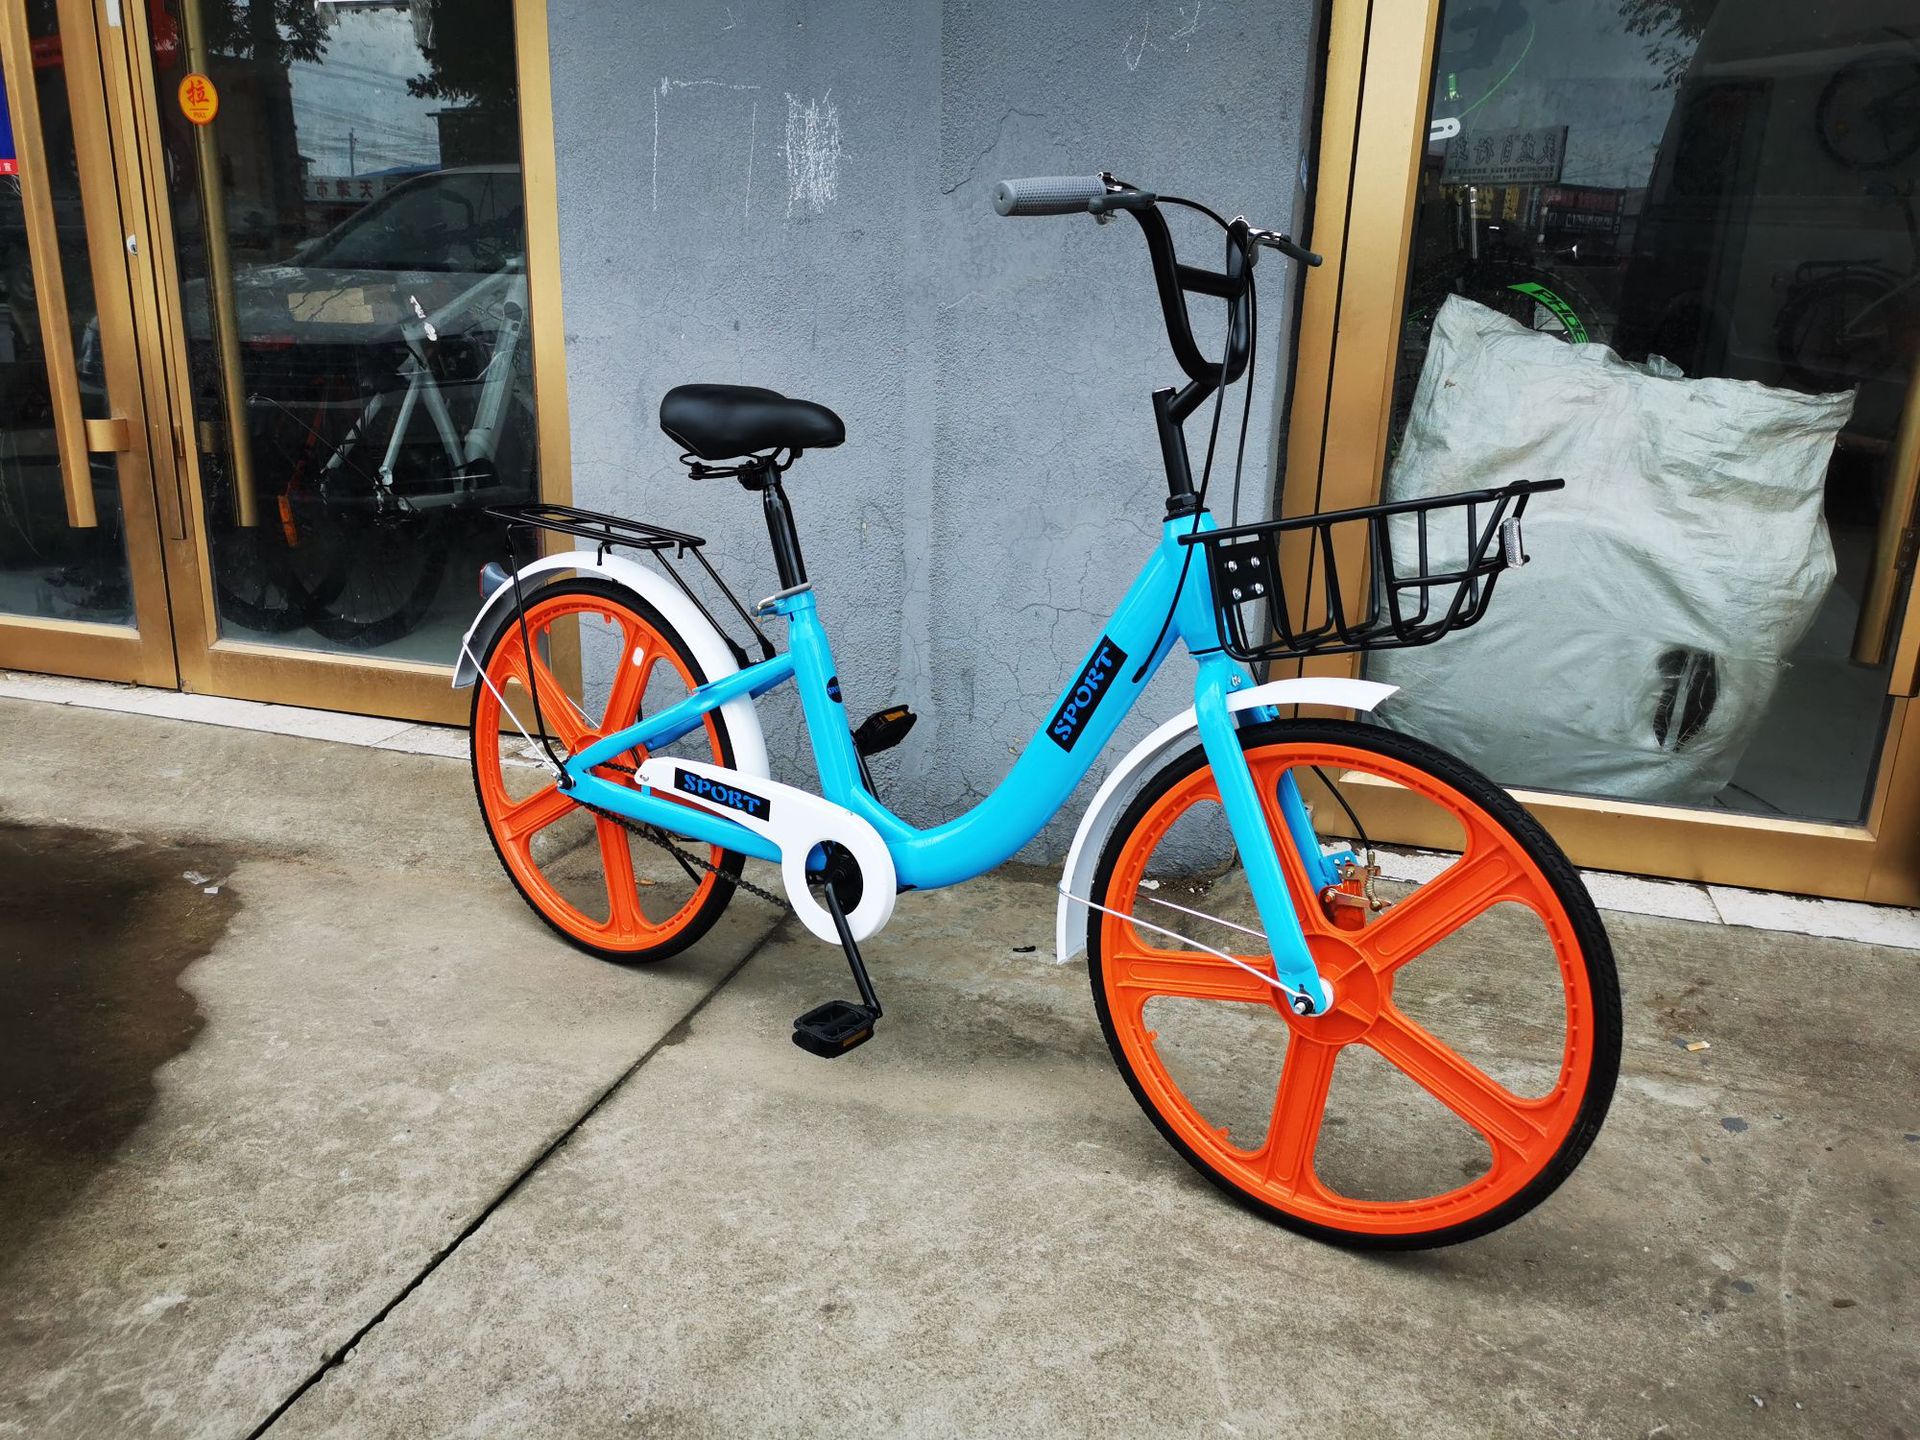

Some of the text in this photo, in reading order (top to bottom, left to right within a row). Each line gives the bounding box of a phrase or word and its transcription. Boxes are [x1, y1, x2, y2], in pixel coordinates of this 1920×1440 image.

[186, 79, 209, 106] 拉
[1054, 646, 1113, 741] SPORT
[683, 774, 761, 813] SPORT
